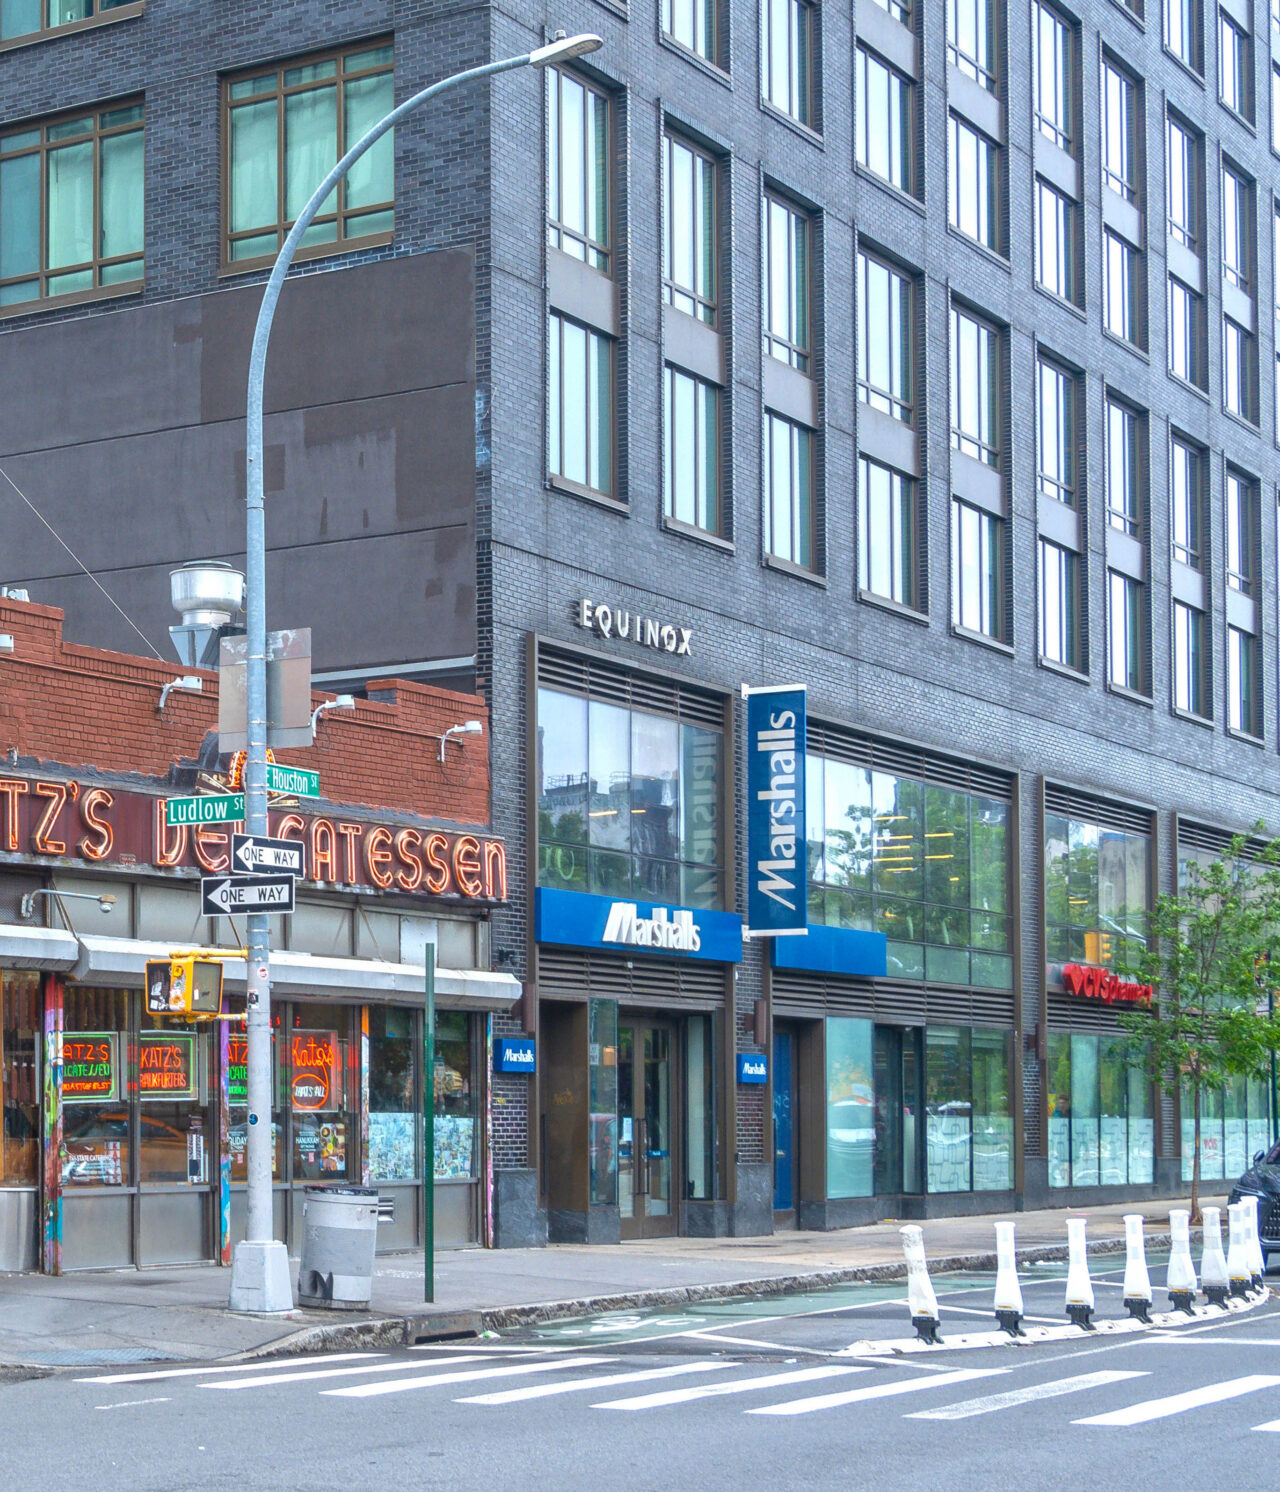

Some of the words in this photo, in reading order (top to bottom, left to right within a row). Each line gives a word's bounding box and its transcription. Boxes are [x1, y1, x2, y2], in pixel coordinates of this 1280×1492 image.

[580, 598, 692, 656] EQUINOX
[272, 768, 308, 793] Houston
[310, 776, 318, 788] St
[170, 799, 227, 822] Ludlow
[234, 797, 244, 810] St
[757, 710, 796, 911] Marshalls
[153, 797, 507, 899] DEATESSEN
[244, 847, 264, 863] ONE
[274, 850, 295, 866] WAY
[220, 888, 245, 904] ONE
[257, 886, 284, 901] WAY
[603, 902, 701, 951] Marshalls
[140, 1044, 182, 1069] KATZ'S
[503, 1048, 535, 1063] Marshalls
[139, 1071, 187, 1089] RANKFURTERS
[742, 1062, 767, 1075] Marshalls
[229, 1136, 248, 1146] OLIDAY
